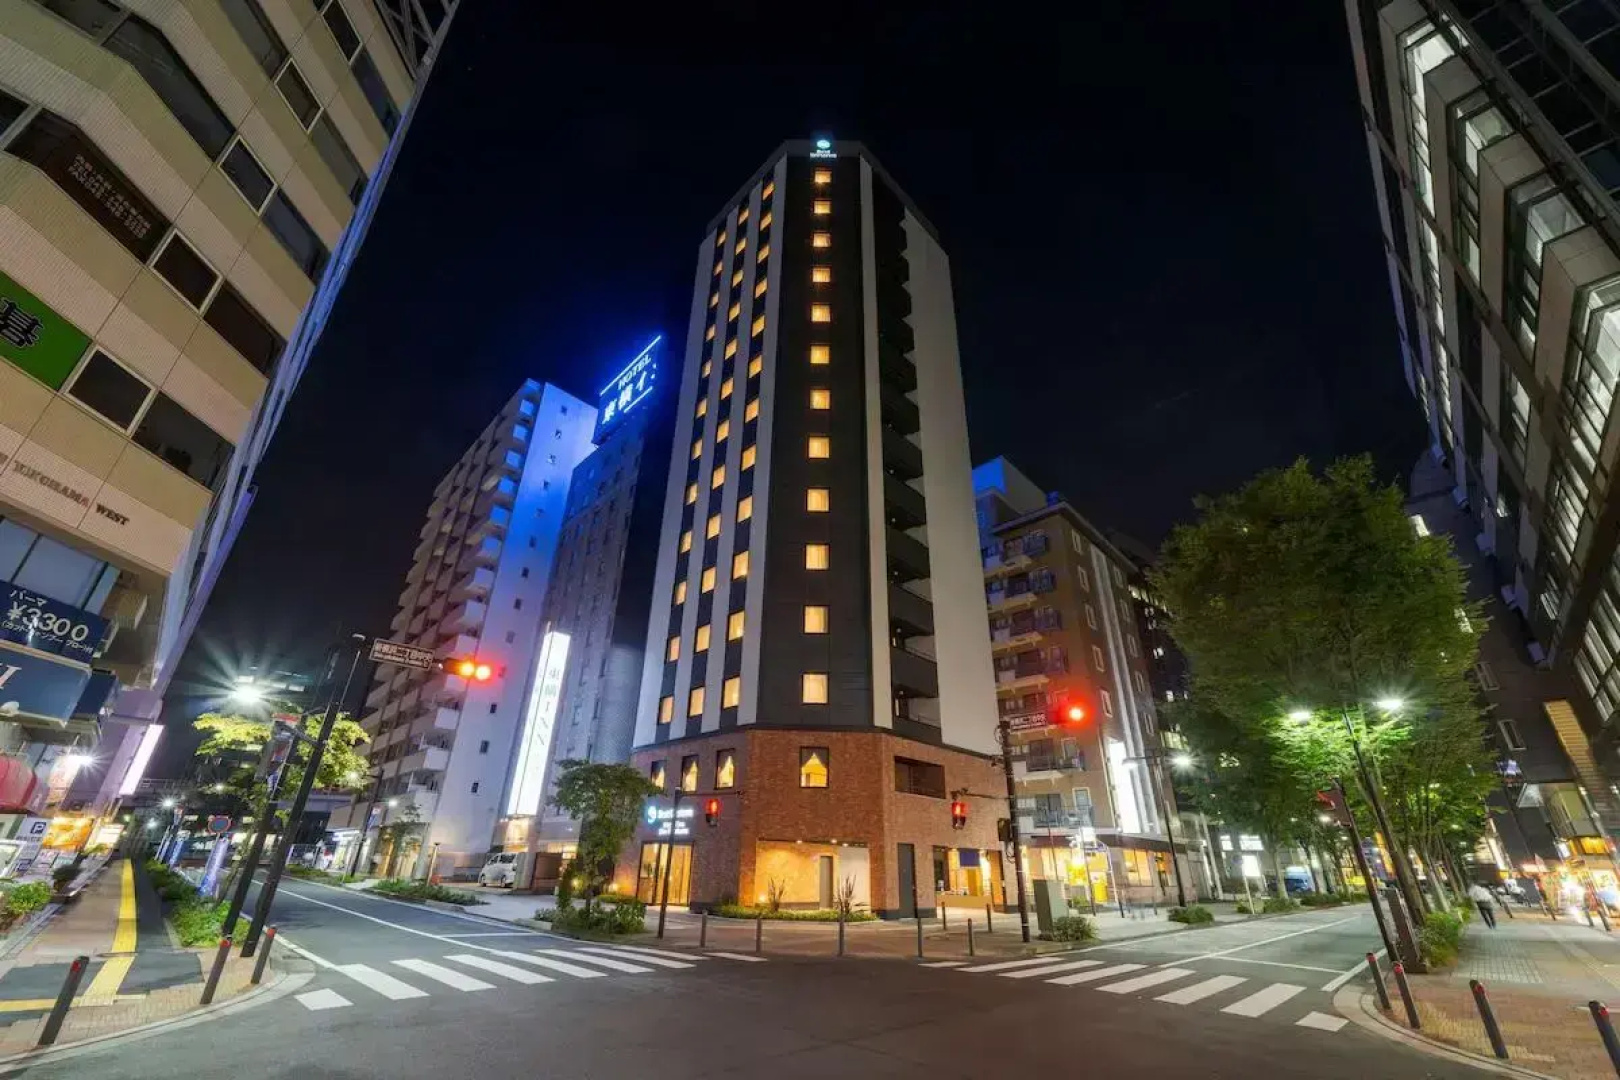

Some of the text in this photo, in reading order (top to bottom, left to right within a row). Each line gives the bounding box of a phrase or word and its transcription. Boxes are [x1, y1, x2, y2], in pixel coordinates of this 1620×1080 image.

[96, 502, 130, 526] WEST
[10, 589, 48, 607] パーマ
[7, 601, 89, 642] ¥3300
